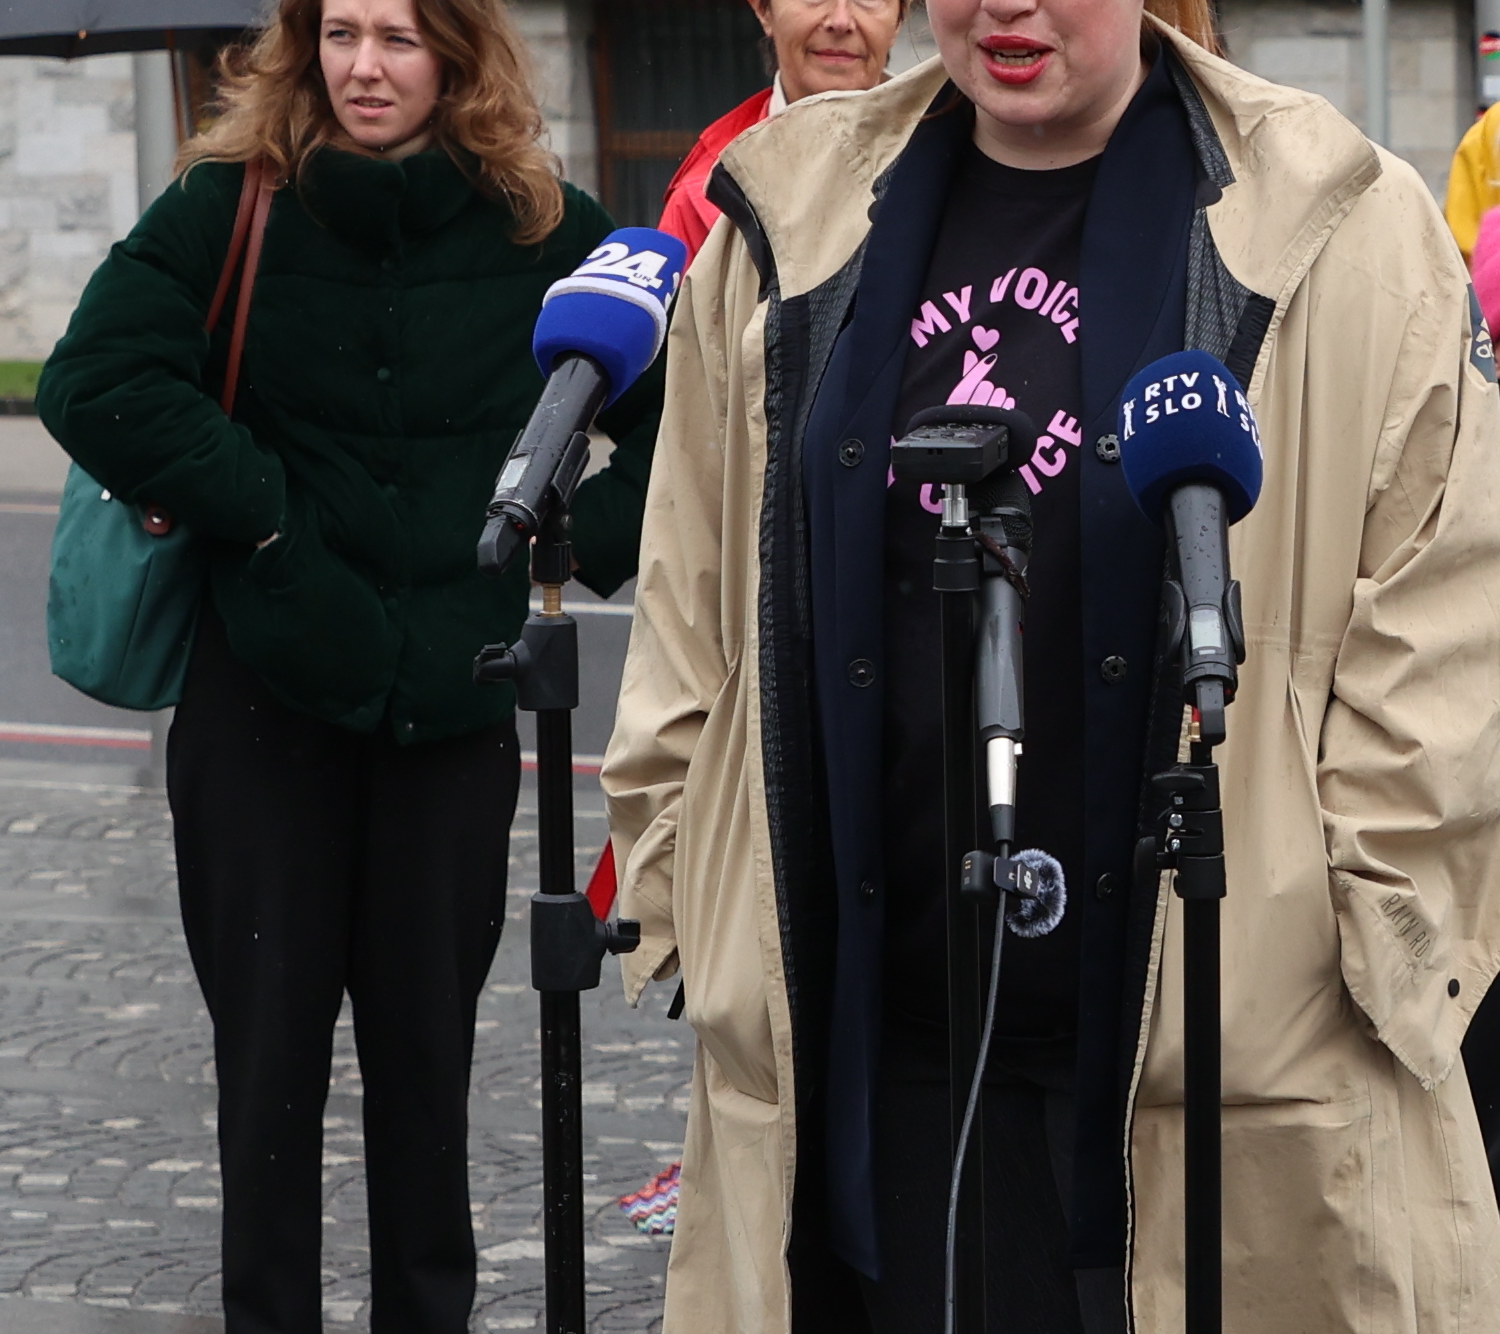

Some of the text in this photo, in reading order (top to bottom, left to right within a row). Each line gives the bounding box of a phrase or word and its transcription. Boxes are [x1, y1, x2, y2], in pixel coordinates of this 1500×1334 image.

[571, 242, 668, 289] 24
[911, 285, 972, 348] MY
[1144, 372, 1200, 402] RTV
[1146, 393, 1202, 423] SLO
[919, 409, 1082, 515] CICE
[1380, 892, 1432, 962] RAIN.RD
